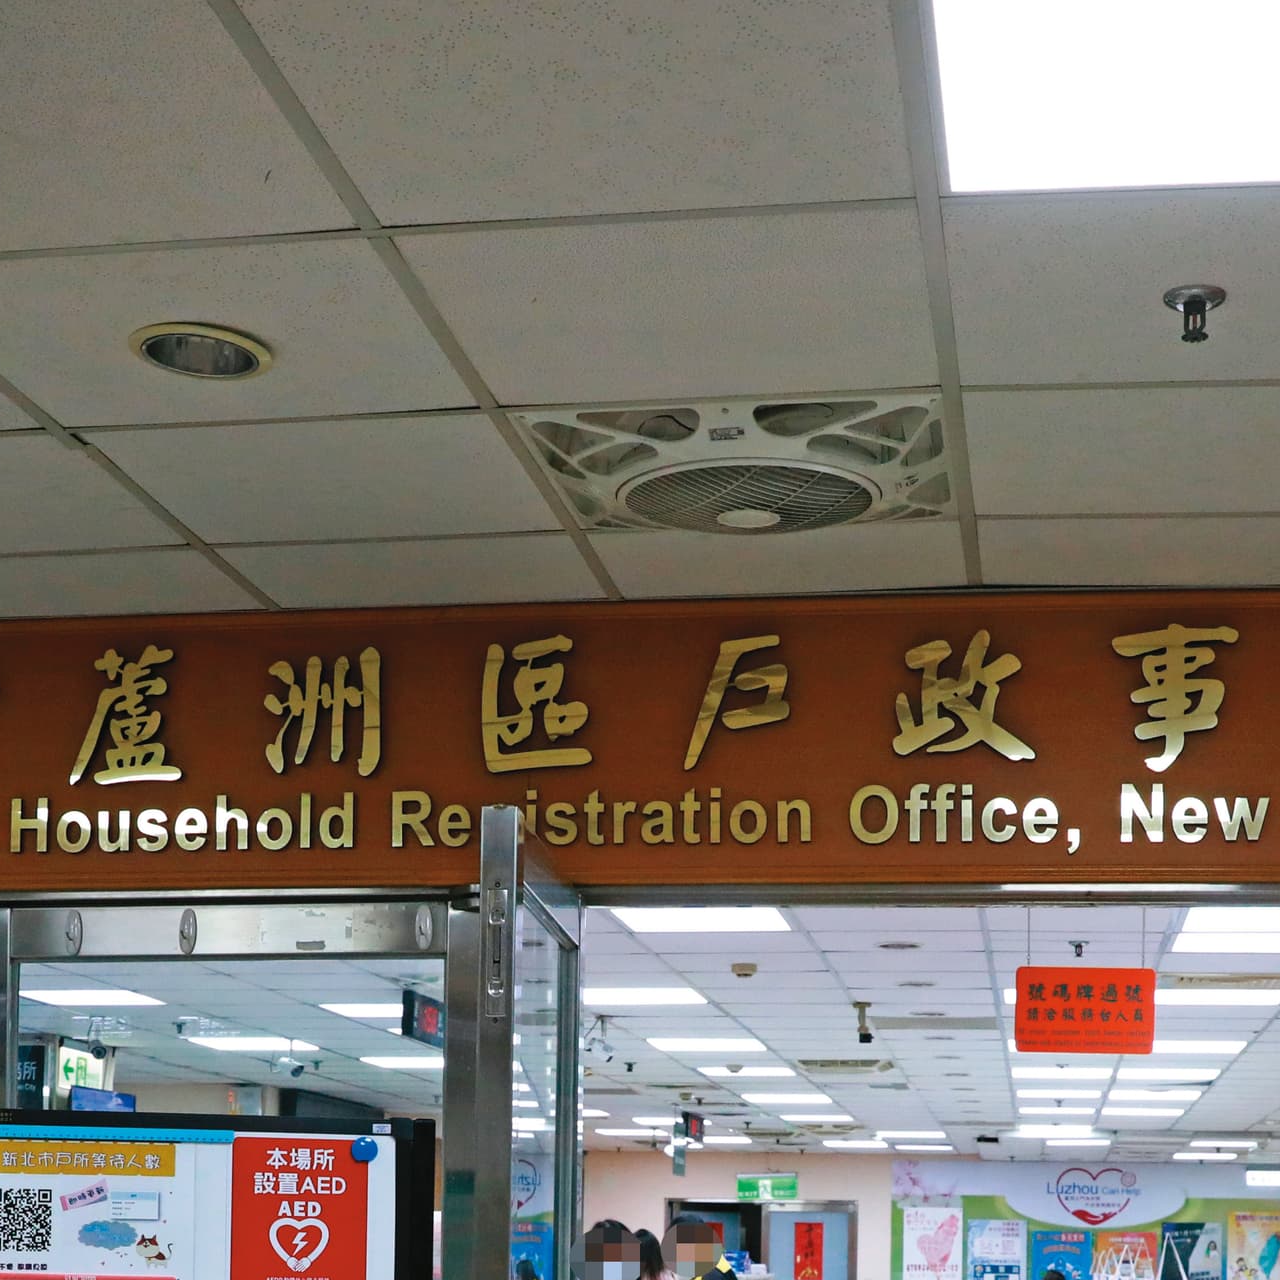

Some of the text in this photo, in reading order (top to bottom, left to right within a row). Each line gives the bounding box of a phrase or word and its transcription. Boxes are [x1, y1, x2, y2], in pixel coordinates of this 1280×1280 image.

[10, 791, 354, 854] Household
[390, 788, 811, 849] Reistration
[849, 783, 1081, 855] Office,
[1120, 782, 1269, 843] New
[2, 1151, 161, 1170] 新北市戶所等待人數
[266, 1148, 335, 1171] 本場所
[254, 1173, 347, 1195] 設置AED
[1046, 1182, 1099, 1195] Luzhou
[278, 1200, 322, 1217] AED
